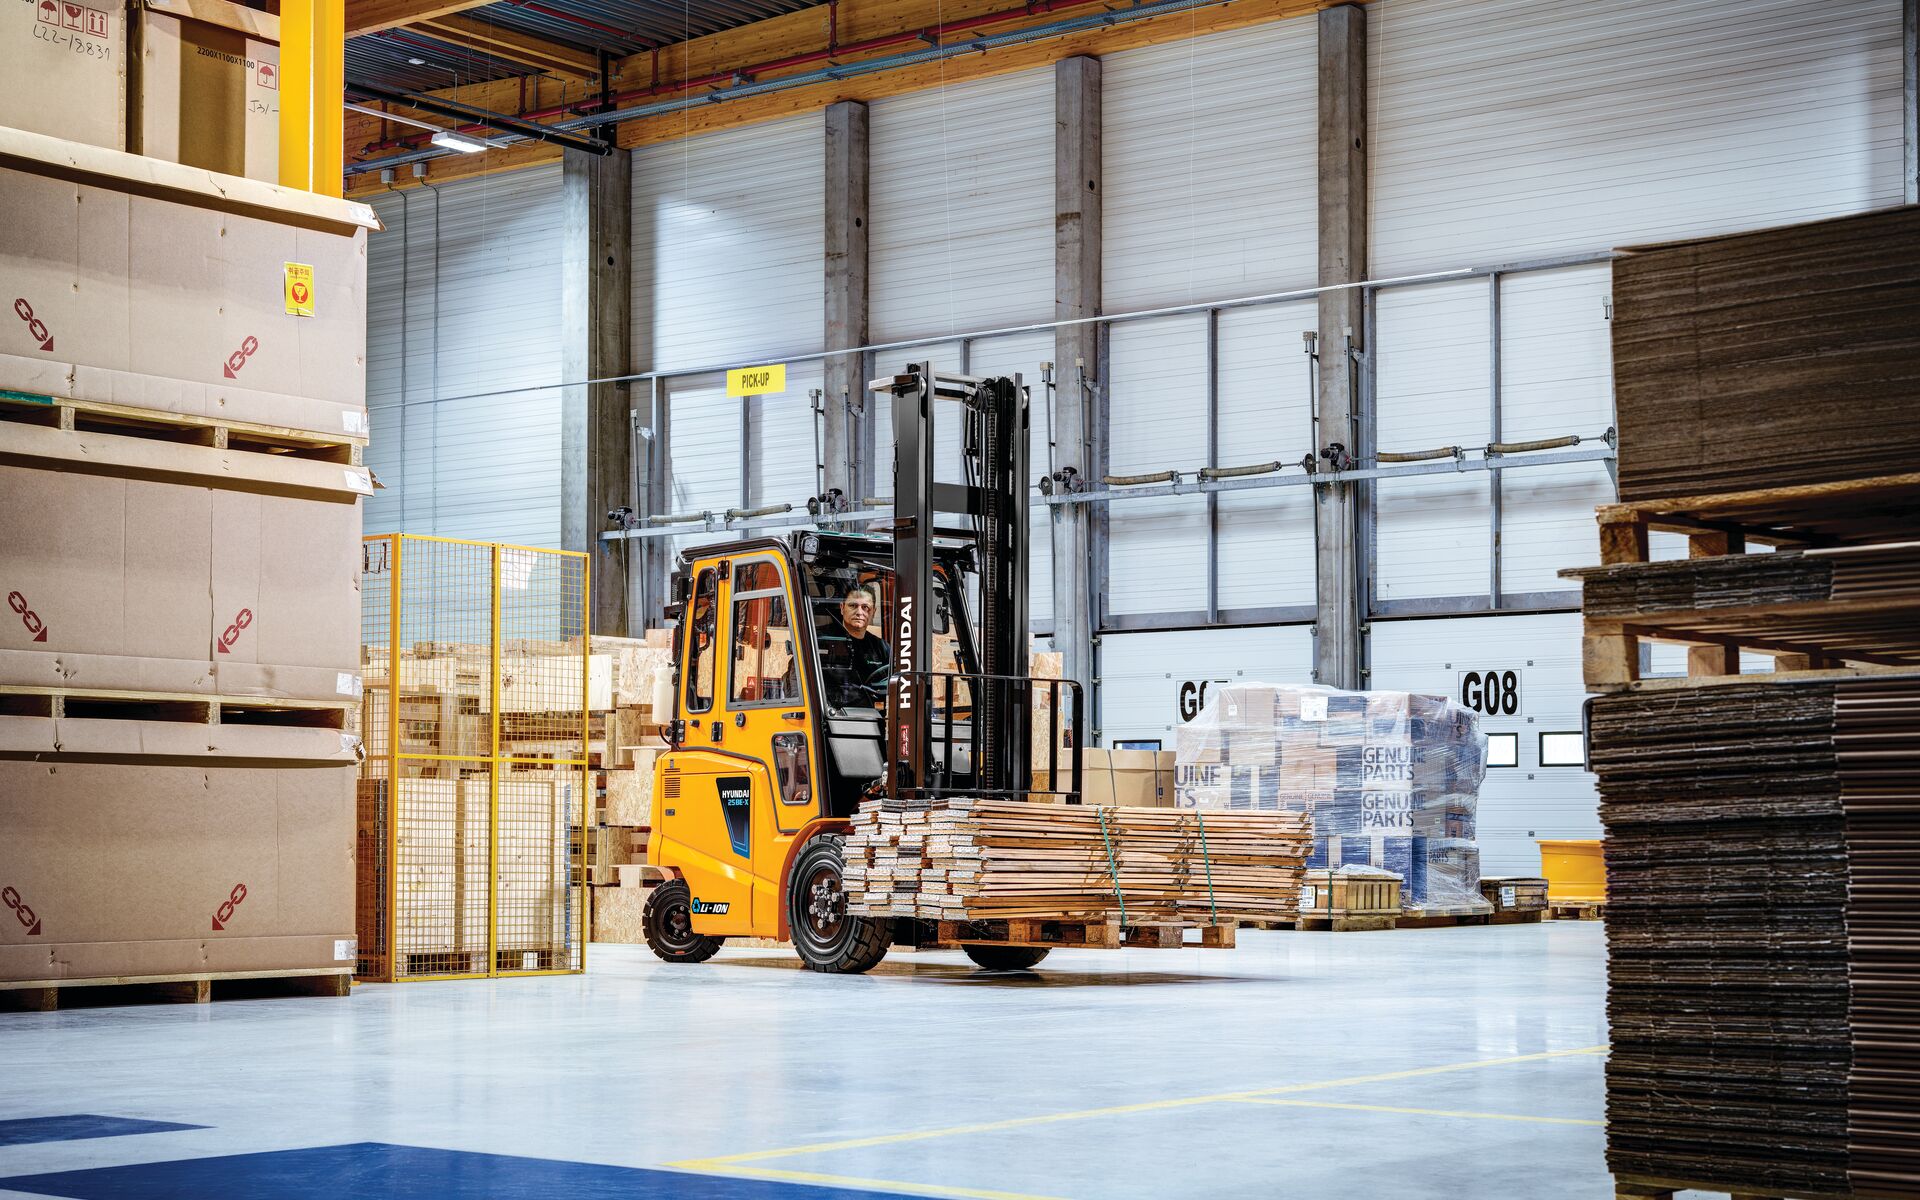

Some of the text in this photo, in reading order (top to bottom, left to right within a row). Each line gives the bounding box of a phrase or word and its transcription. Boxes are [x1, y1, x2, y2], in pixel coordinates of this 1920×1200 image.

[742, 372, 770, 388] PICK-UP
[900, 596, 911, 709] HYUNDAI
[1463, 671, 1518, 715] G08
[1363, 746, 1426, 763] GENUINE
[1174, 766, 1221, 786] UINE
[1364, 764, 1415, 780] PARTS
[722, 790, 750, 798] HYUNDAI
[1362, 793, 1426, 810] GENUINE
[1363, 811, 1414, 827] PARTS
